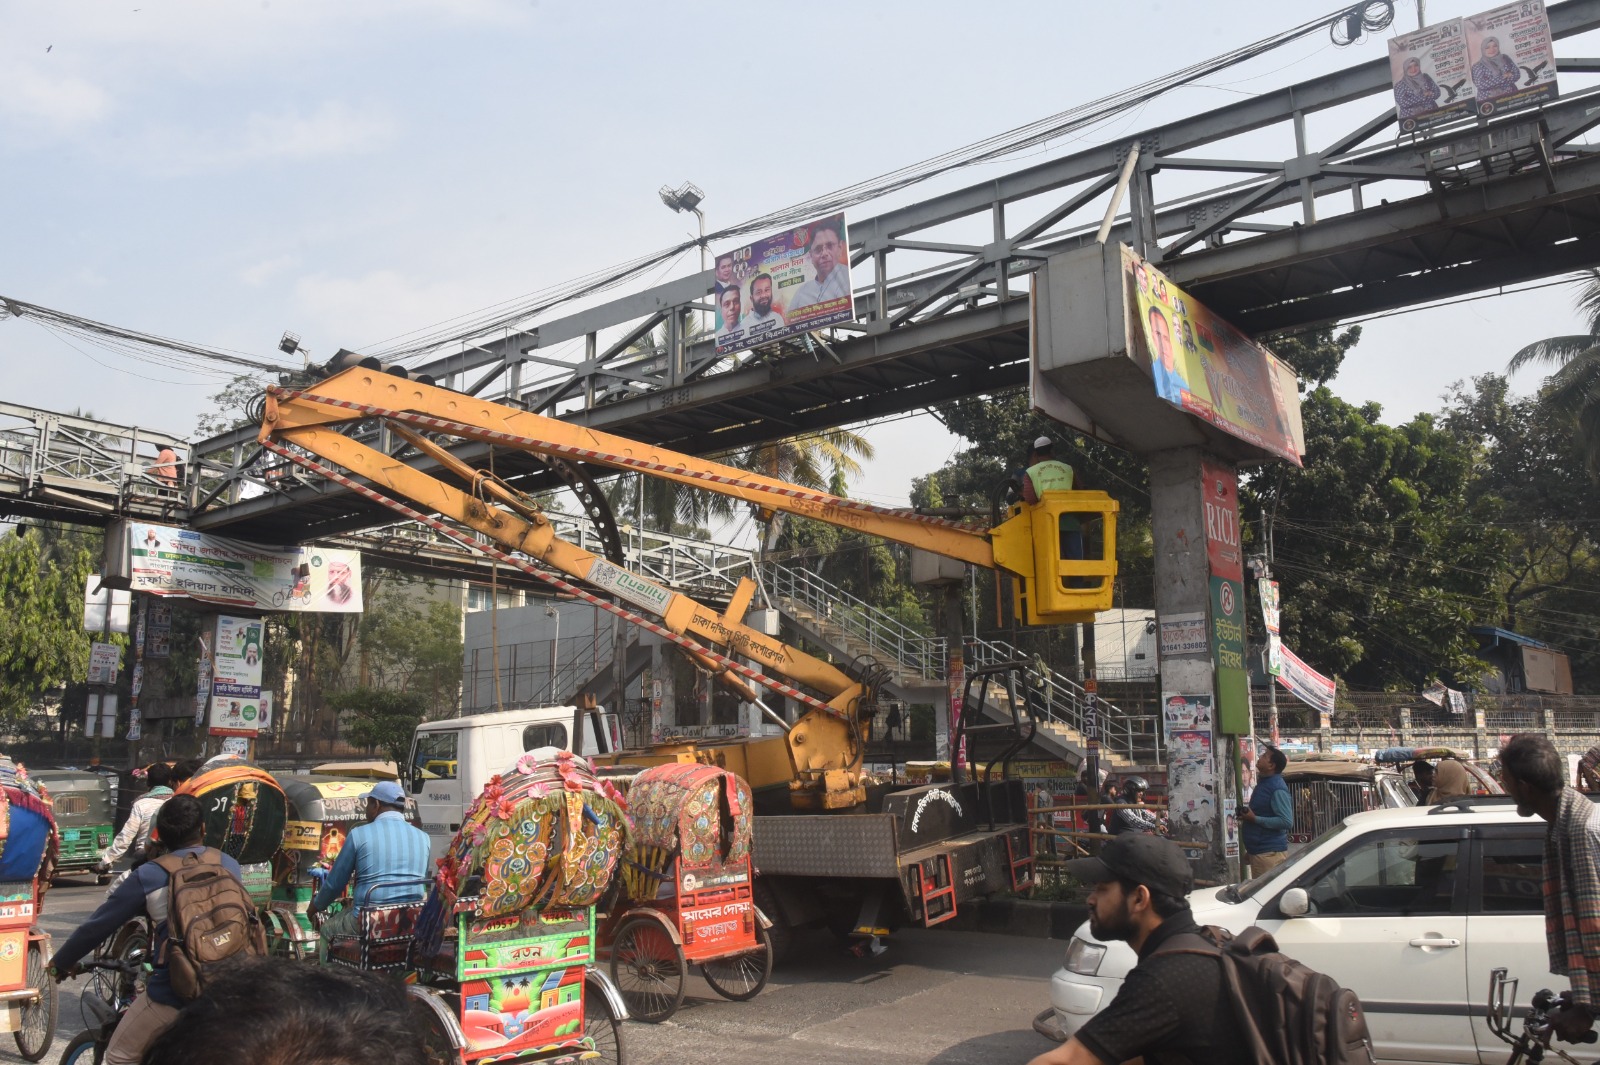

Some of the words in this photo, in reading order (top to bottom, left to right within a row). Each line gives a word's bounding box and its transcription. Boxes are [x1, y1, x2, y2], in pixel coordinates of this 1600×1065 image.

[791, 258, 804, 268] নিন
[736, 342, 745, 350] নং
[746, 334, 763, 345] ওয়ার্ড
[796, 322, 809, 331] ঢাকা
[810, 316, 832, 327] মহানগর
[833, 312, 850, 322] দক্ষিণ
[1206, 501, 1237, 547] RICL
[164, 552, 198, 564] ঢাকা-১০
[169, 540, 196, 555] আসন্ন
[200, 545, 229, 559] জাতীয়
[257, 550, 293, 566] নির্বাচনে
[149, 562, 186, 573] বাংলাদেশ
[137, 573, 172, 587] মুফতি
[177, 577, 216, 593] ইলিয়াস
[221, 583, 255, 598] হামিদী
[616, 571, 668, 605] Quality
[692, 613, 709, 631] ঢাকা
[710, 619, 733, 641] দক্ষিণ
[734, 630, 750, 647] সিটি
[1163, 629, 1184, 644] হাতের
[1188, 627, 1205, 641] লেখা
[1215, 617, 1242, 643] ইউটার্ন
[1218, 643, 1242, 669] নিষেধ
[211, 796, 228, 813] ১৭
[911, 811, 921, 833] ঢাকা
[939, 789, 963, 818] কর্পোরেশন
[294, 825, 315, 837] DOT
[214, 931, 231, 947] CAT
[696, 920, 738, 938] জান্নাত
[510, 947, 543, 961] রতন
